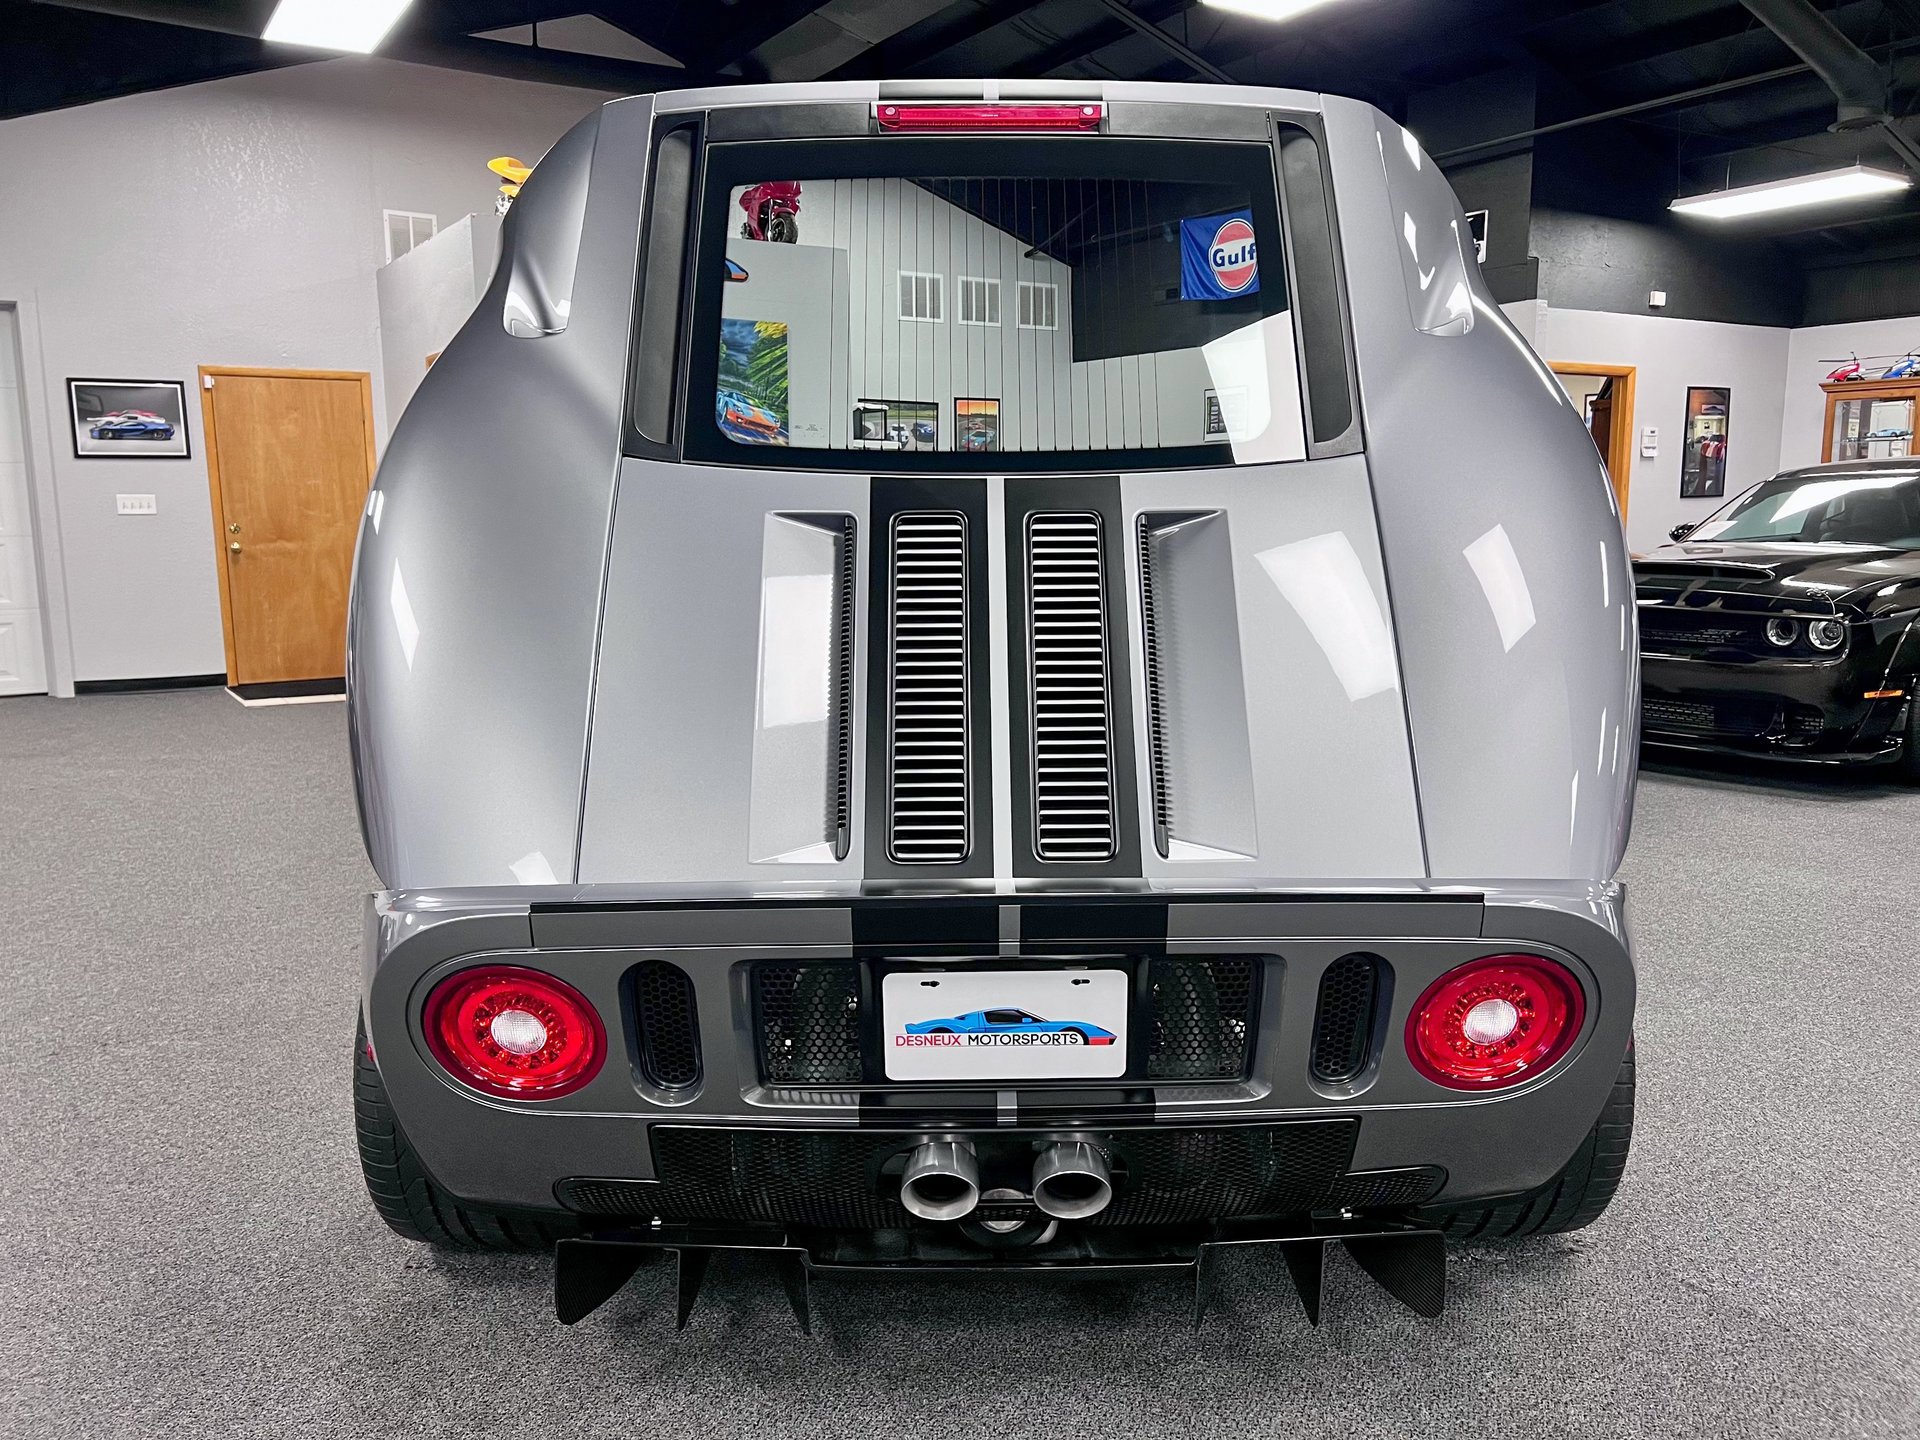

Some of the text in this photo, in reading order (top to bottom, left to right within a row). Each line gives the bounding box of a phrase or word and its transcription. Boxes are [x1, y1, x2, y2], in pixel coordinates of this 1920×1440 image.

[1213, 242, 1256, 267] Gulf
[895, 1033, 1079, 1047] DESNEUX MOTORSPORTS
